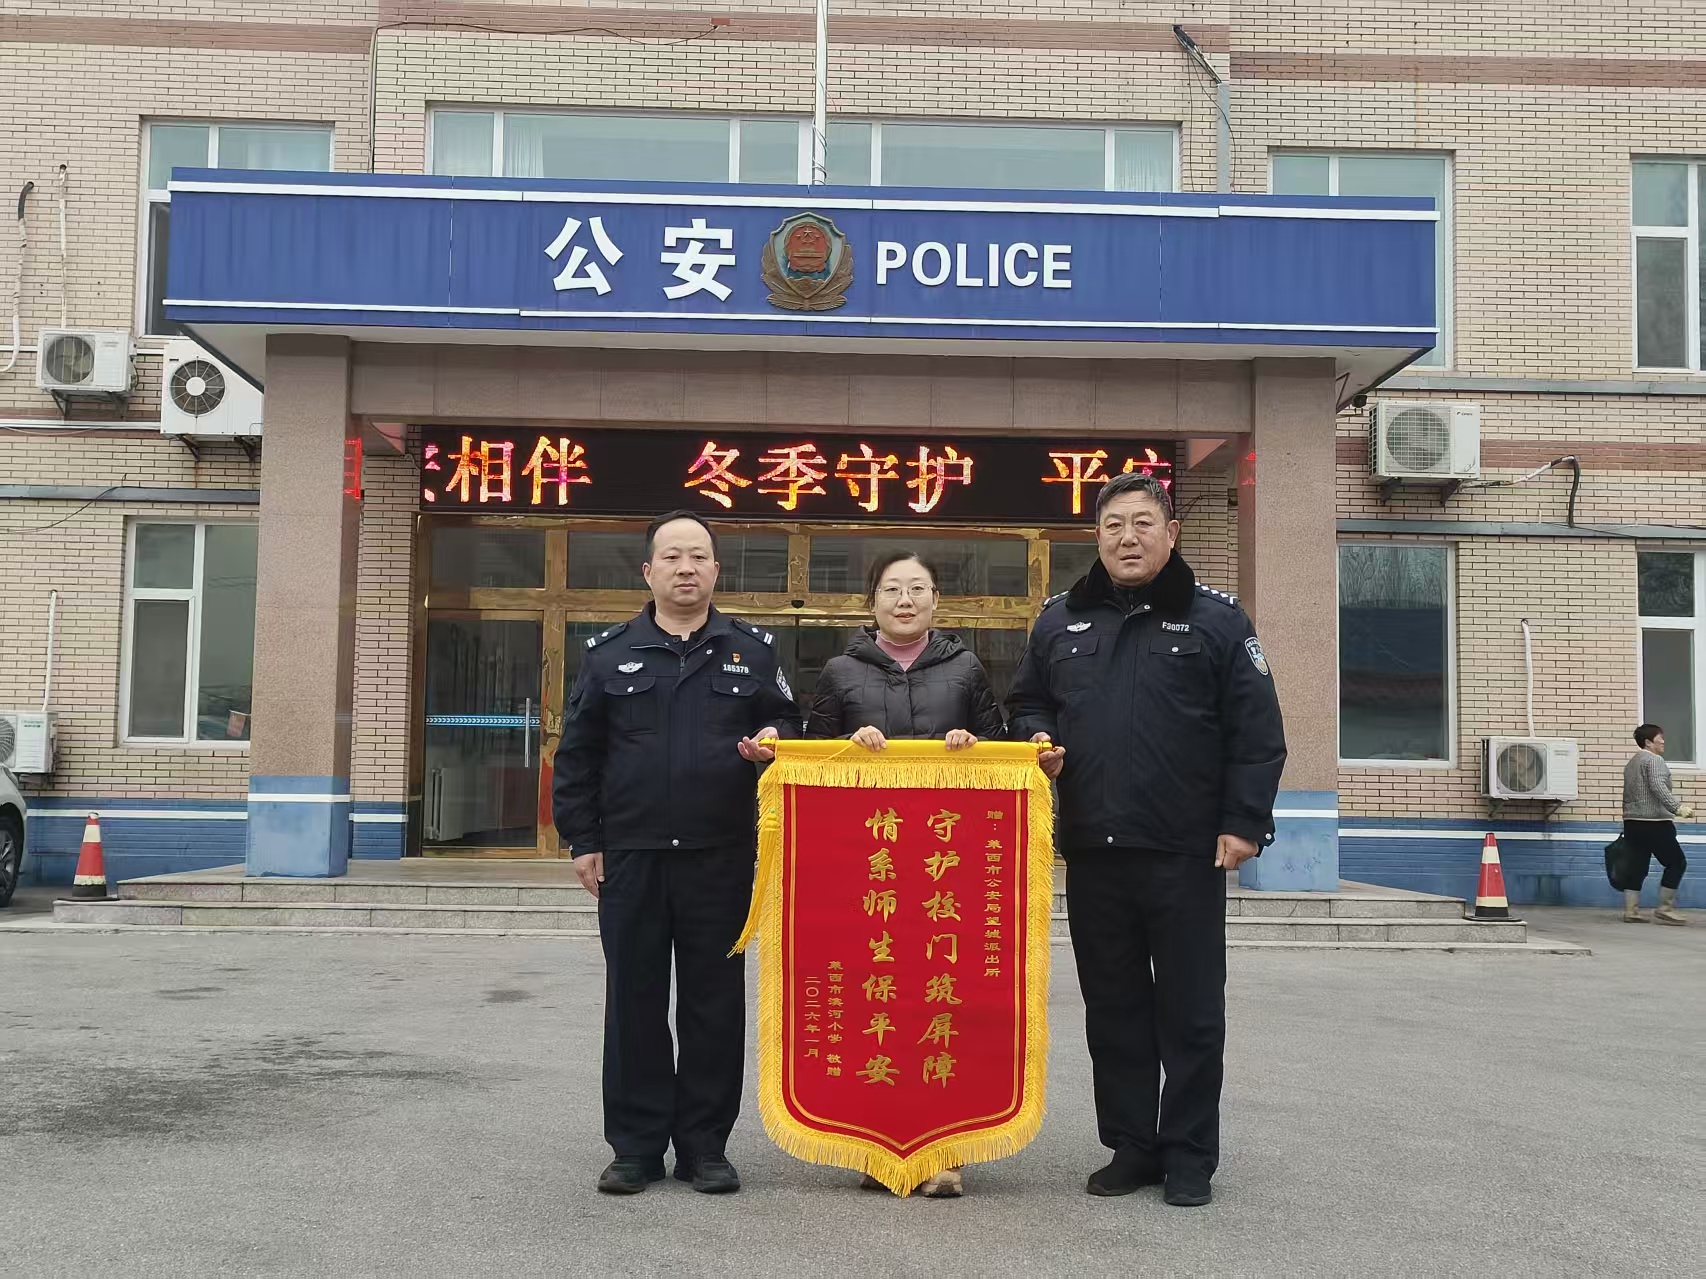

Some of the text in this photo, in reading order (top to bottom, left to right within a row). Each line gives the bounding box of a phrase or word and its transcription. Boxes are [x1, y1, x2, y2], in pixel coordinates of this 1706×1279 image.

[545, 216, 736, 301] 公安
[876, 241, 1072, 288] POLICE
[684, 441, 974, 513] 冬季守护
[856, 807, 904, 1086] 情系师生保平安
[917, 808, 962, 1088] 守护校门筑屏障
